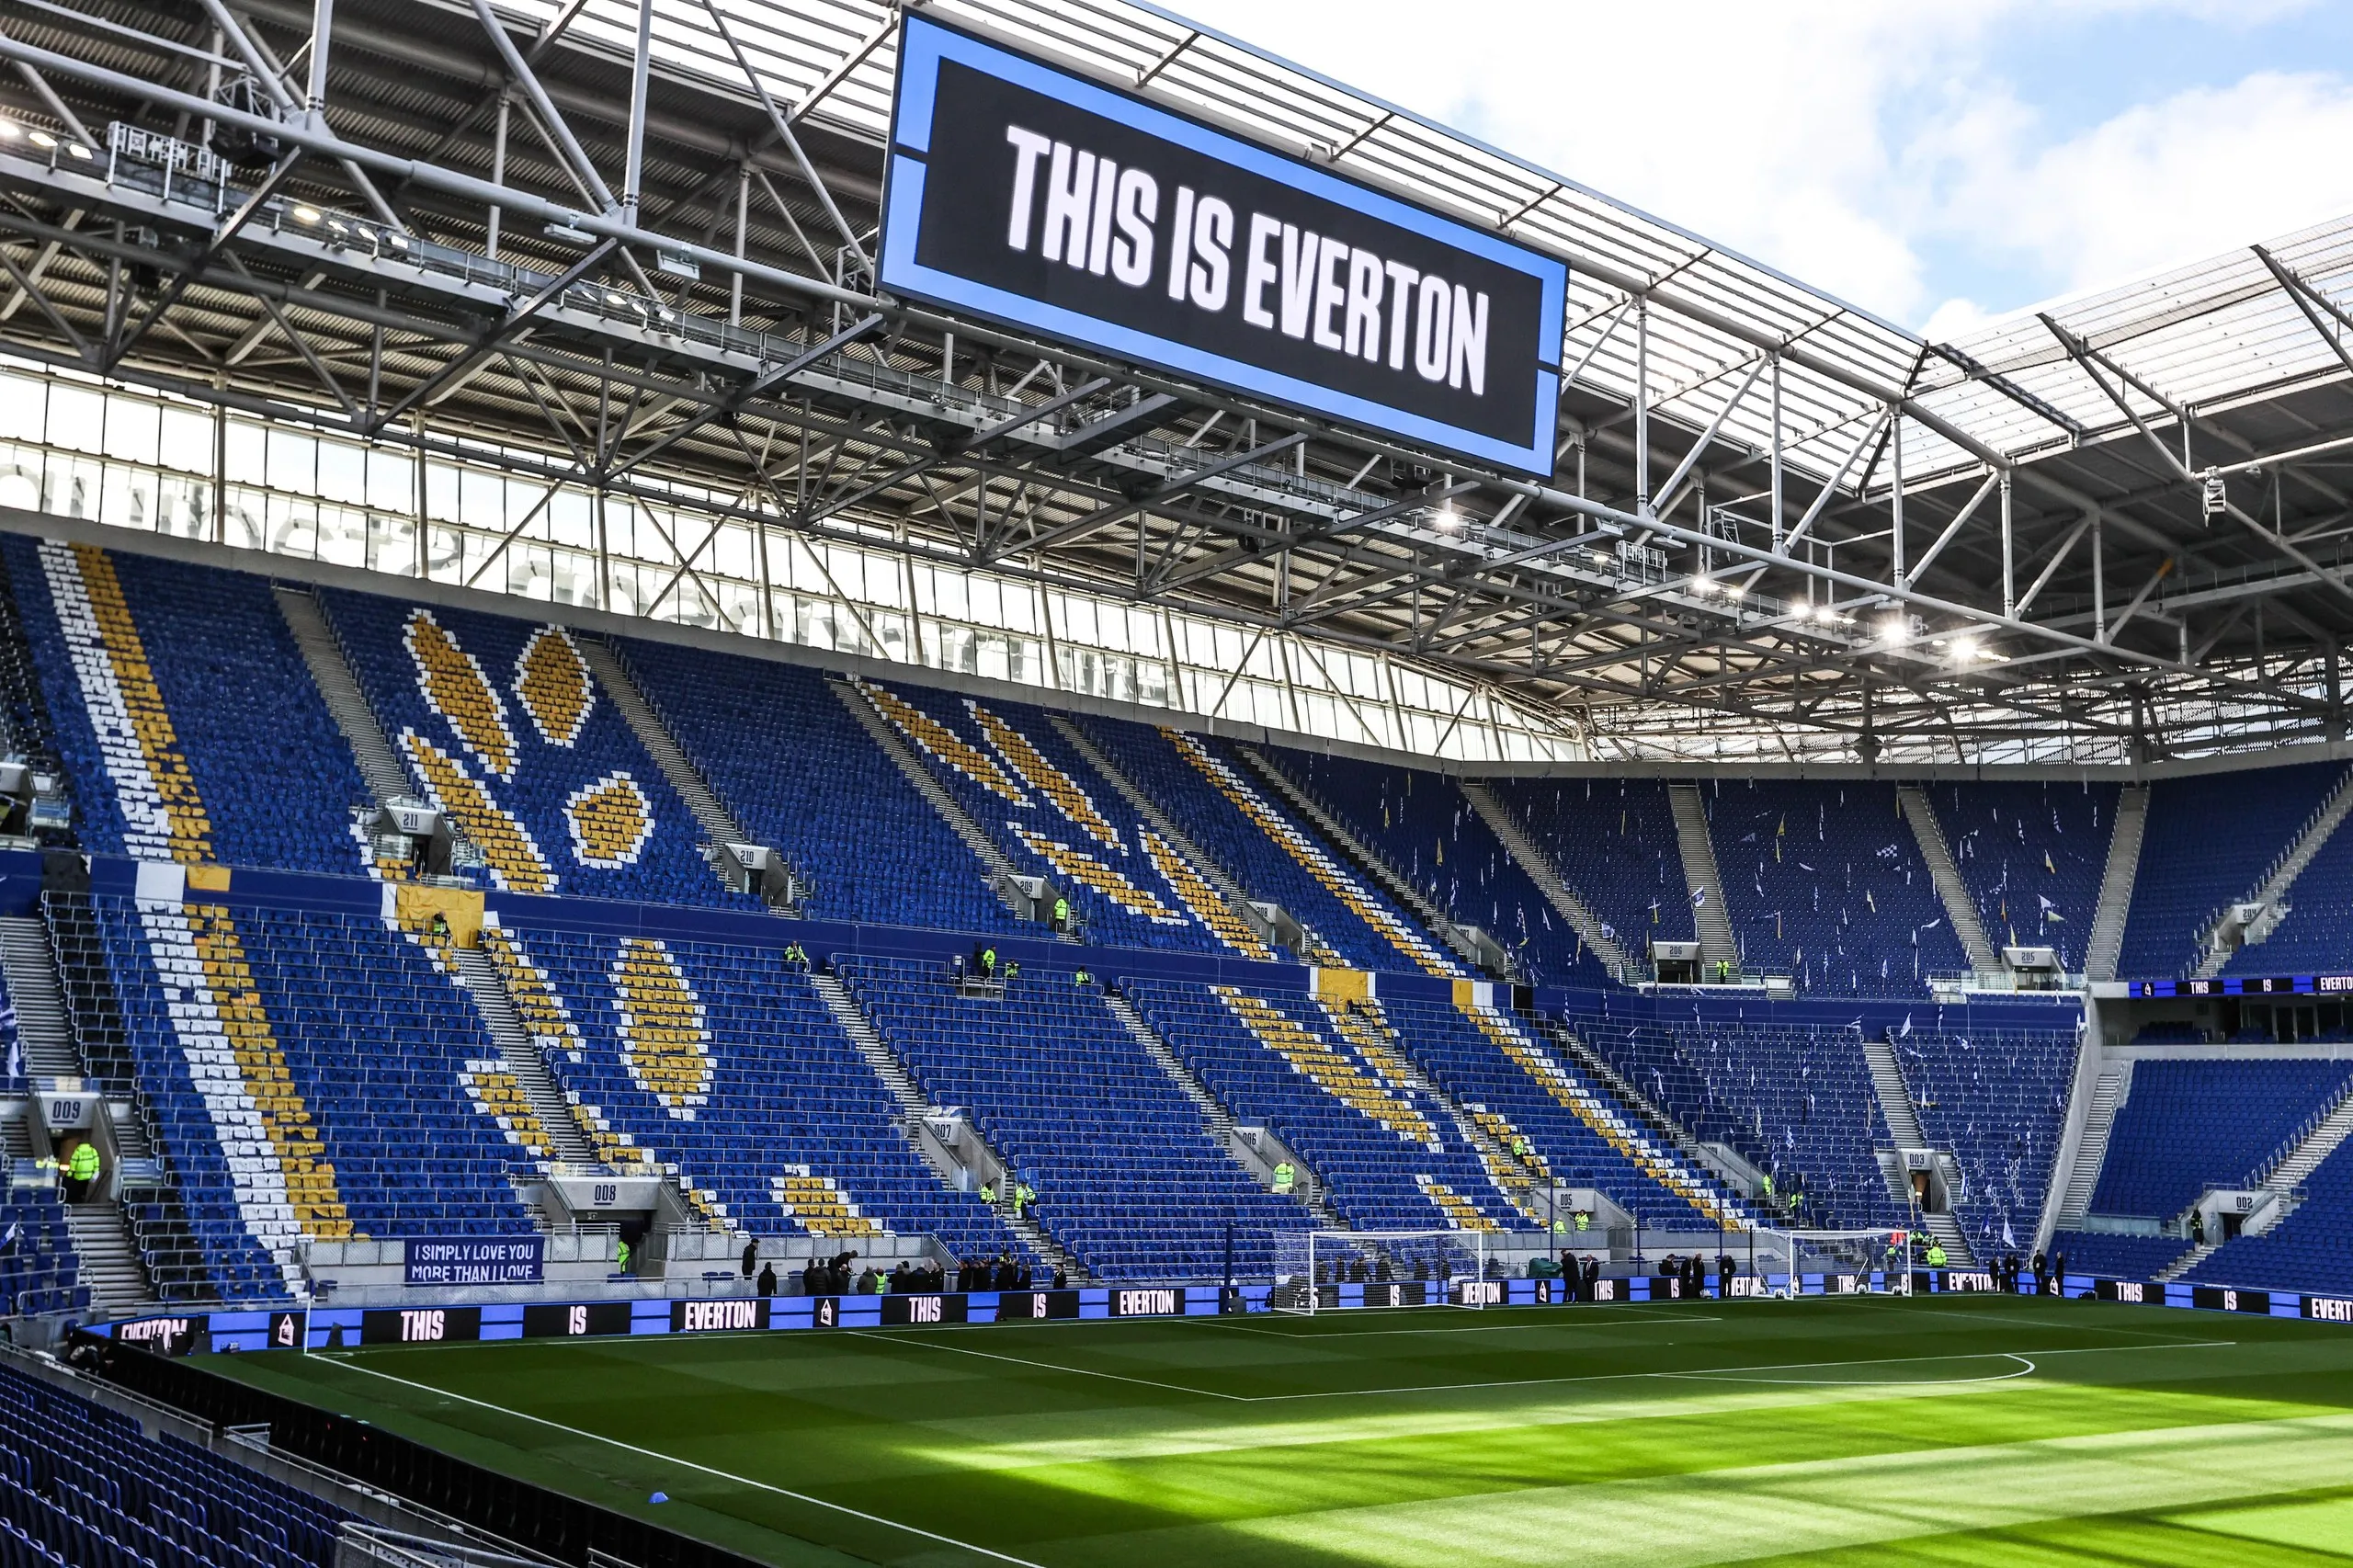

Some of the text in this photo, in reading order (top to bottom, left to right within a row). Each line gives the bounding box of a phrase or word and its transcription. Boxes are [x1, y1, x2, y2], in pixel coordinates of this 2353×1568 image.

[1006, 125, 1489, 397] THIS IS EVERTON
[403, 813, 418, 827] 211
[740, 850, 755, 863] 210
[1019, 881, 1033, 892] 209
[1669, 946, 1683, 955] 206
[2021, 951, 2035, 961] 205
[2190, 981, 2209, 994] THIS
[2263, 979, 2272, 992] IS
[52, 1101, 81, 1119] 009
[934, 1124, 951, 1138] 007
[1909, 1153, 1925, 1165] 003
[595, 1185, 617, 1201] 008
[1561, 1194, 1573, 1206] 005
[2236, 1197, 2252, 1209] 002
[415, 1244, 534, 1260] I SIMPLY LOVE YOU
[412, 1265, 533, 1282] MORE THAN I LOVE
[1594, 1279, 1614, 1301] THIS
[1671, 1278, 1680, 1299] IS
[1837, 1275, 1855, 1293] THIS
[1390, 1282, 1500, 1307] IS VERTON
[2116, 1281, 2353, 1322] THIS IS EVERT
[909, 1290, 1175, 1323] THIS IS EVERTON
[400, 1301, 756, 1342] THIS IS EVERTON
